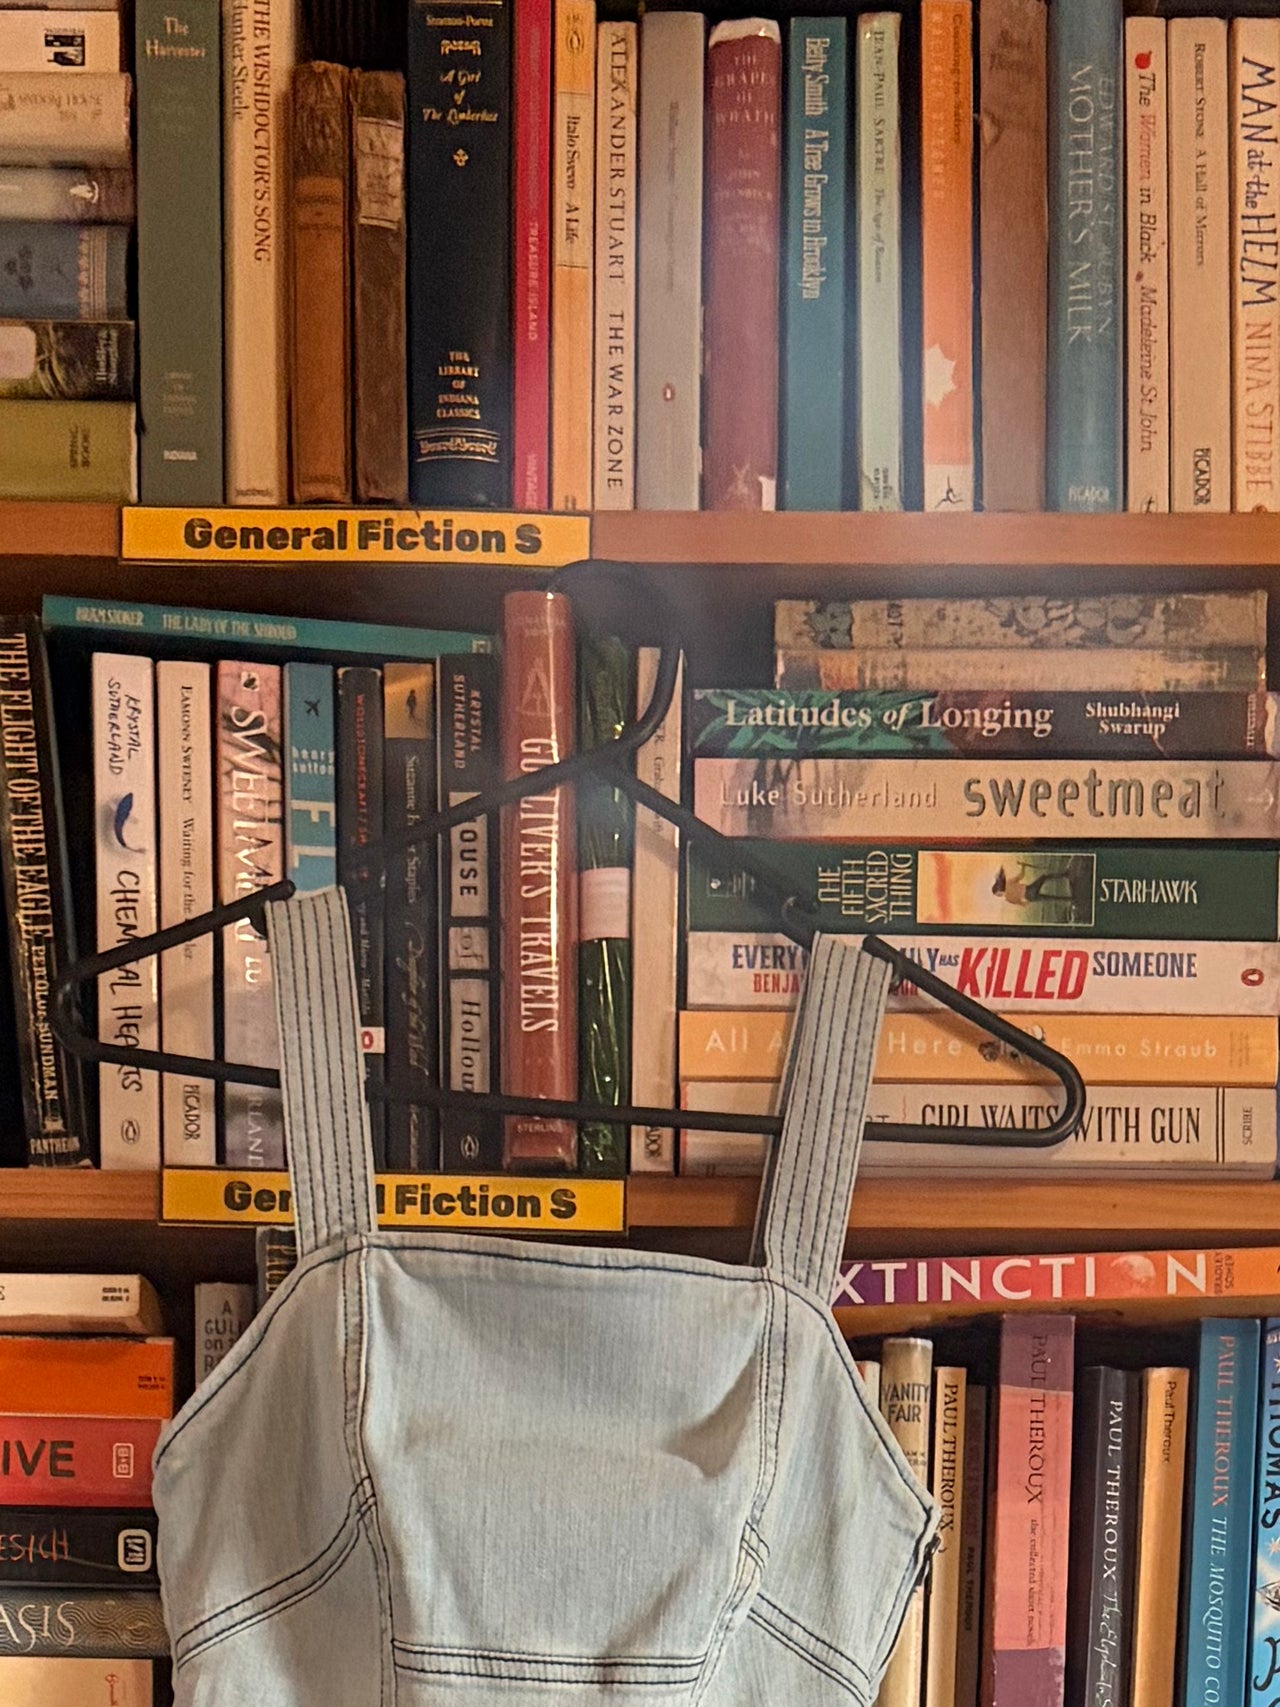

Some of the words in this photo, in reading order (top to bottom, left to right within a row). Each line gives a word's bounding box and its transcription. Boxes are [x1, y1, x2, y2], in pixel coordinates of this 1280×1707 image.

[608, 30, 629, 179] ALEXANDER
[607, 184, 625, 283] STUART
[607, 310, 624, 354] THE
[607, 359, 624, 416] WAR
[607, 424, 624, 491] ZONE
[184, 518, 349, 552] General
[357, 520, 505, 553] Fiction
[515, 522, 541, 553] S
[726, 699, 873, 727] Latitudes
[883, 703, 908, 729] of
[925, 703, 1054, 736] Longing
[963, 769, 1226, 819] sweetmeat
[1099, 878, 1198, 905] STARHAWK
[1093, 952, 1197, 978] SOMEONE
[396, 1185, 541, 1218] Fiction
[550, 1189, 576, 1218] S
